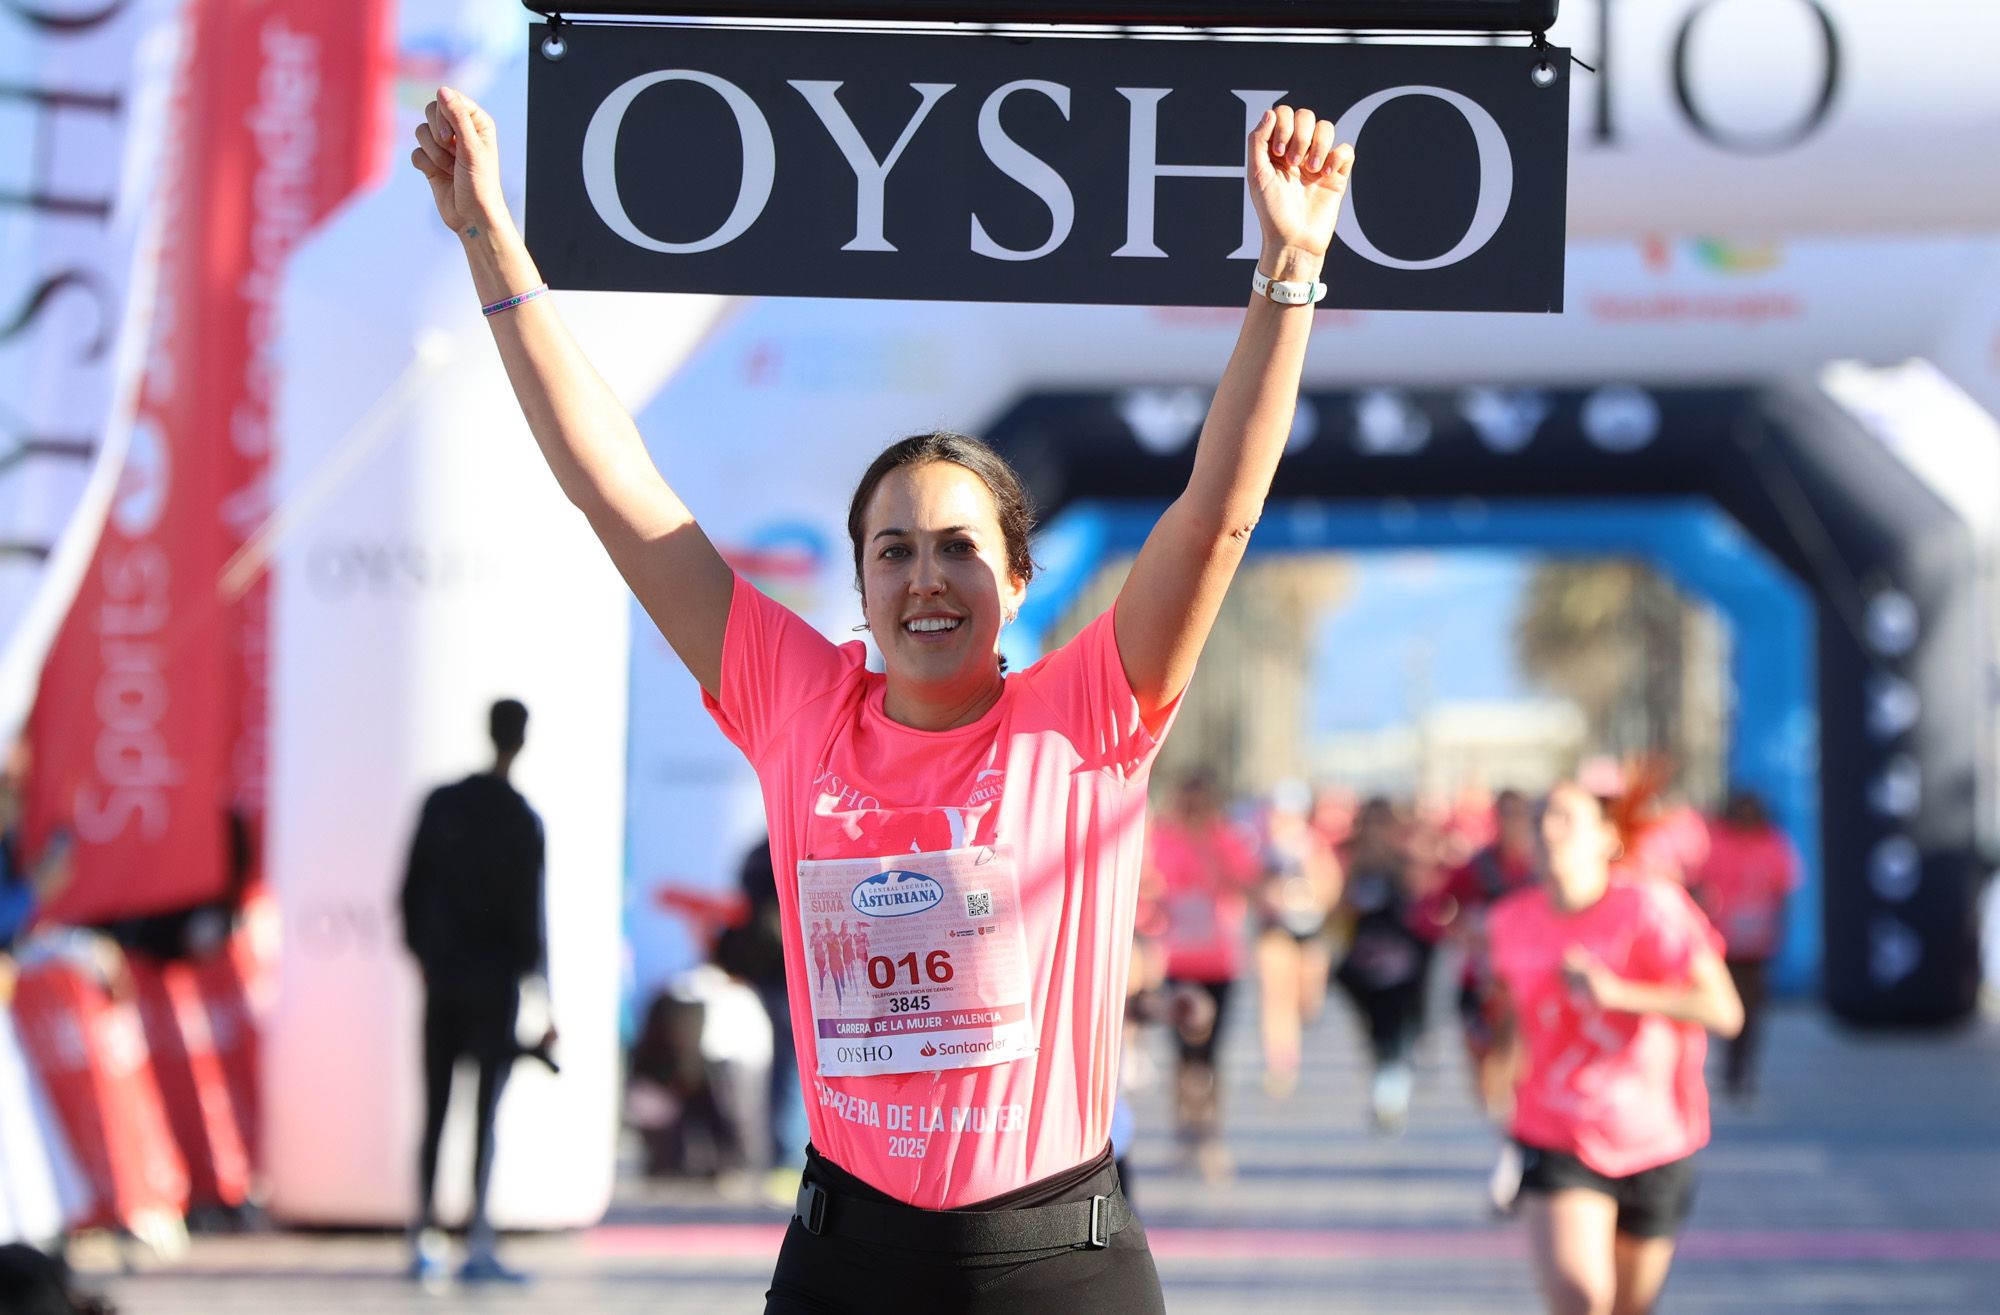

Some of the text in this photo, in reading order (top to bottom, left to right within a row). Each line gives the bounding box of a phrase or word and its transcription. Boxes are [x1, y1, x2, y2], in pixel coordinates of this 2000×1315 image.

[582, 68, 1514, 271] OYSHO
[817, 890, 844, 900] DORSAL
[858, 889, 938, 908] ASTURIANA
[868, 885, 899, 894] CENTRAL
[811, 900, 845, 913] SUMA
[867, 949, 954, 990] 016
[889, 995, 931, 1013] 3845
[836, 1010, 1003, 1034] CARRERA DE LA MUJER VALENCIA
[837, 1038, 1007, 1064] OYSHO Santander
[886, 1103, 914, 1132] DE
[919, 1105, 946, 1133] LA
[951, 1103, 1024, 1134] MUJER
[888, 1135, 927, 1159] 2025
